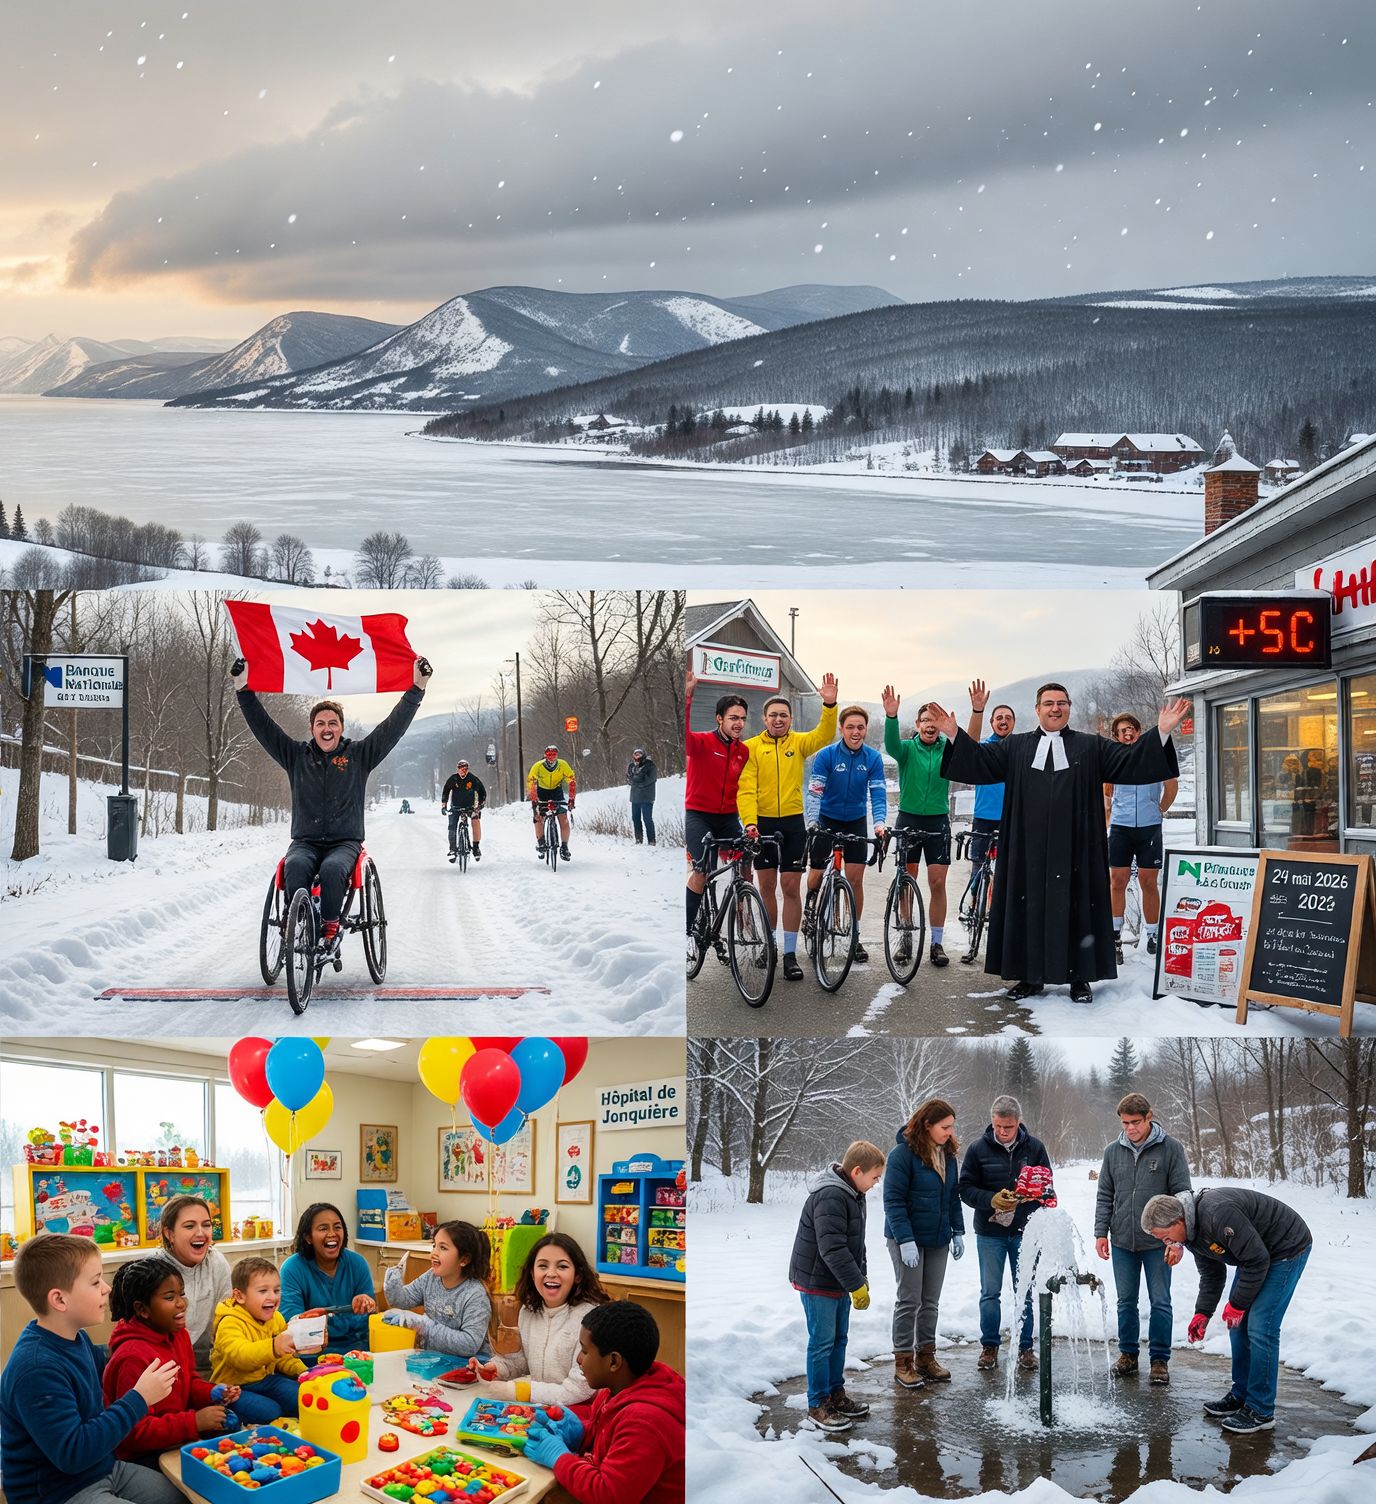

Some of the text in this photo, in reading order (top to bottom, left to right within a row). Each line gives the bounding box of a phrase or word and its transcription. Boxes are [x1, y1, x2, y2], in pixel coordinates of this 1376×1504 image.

[1271, 868, 1289, 884] 24
[1292, 872, 1312, 886] mai
[1314, 871, 1349, 889] 2026
[601, 1084, 676, 1108] Hôpital de
[602, 1103, 679, 1125] Jonquière
